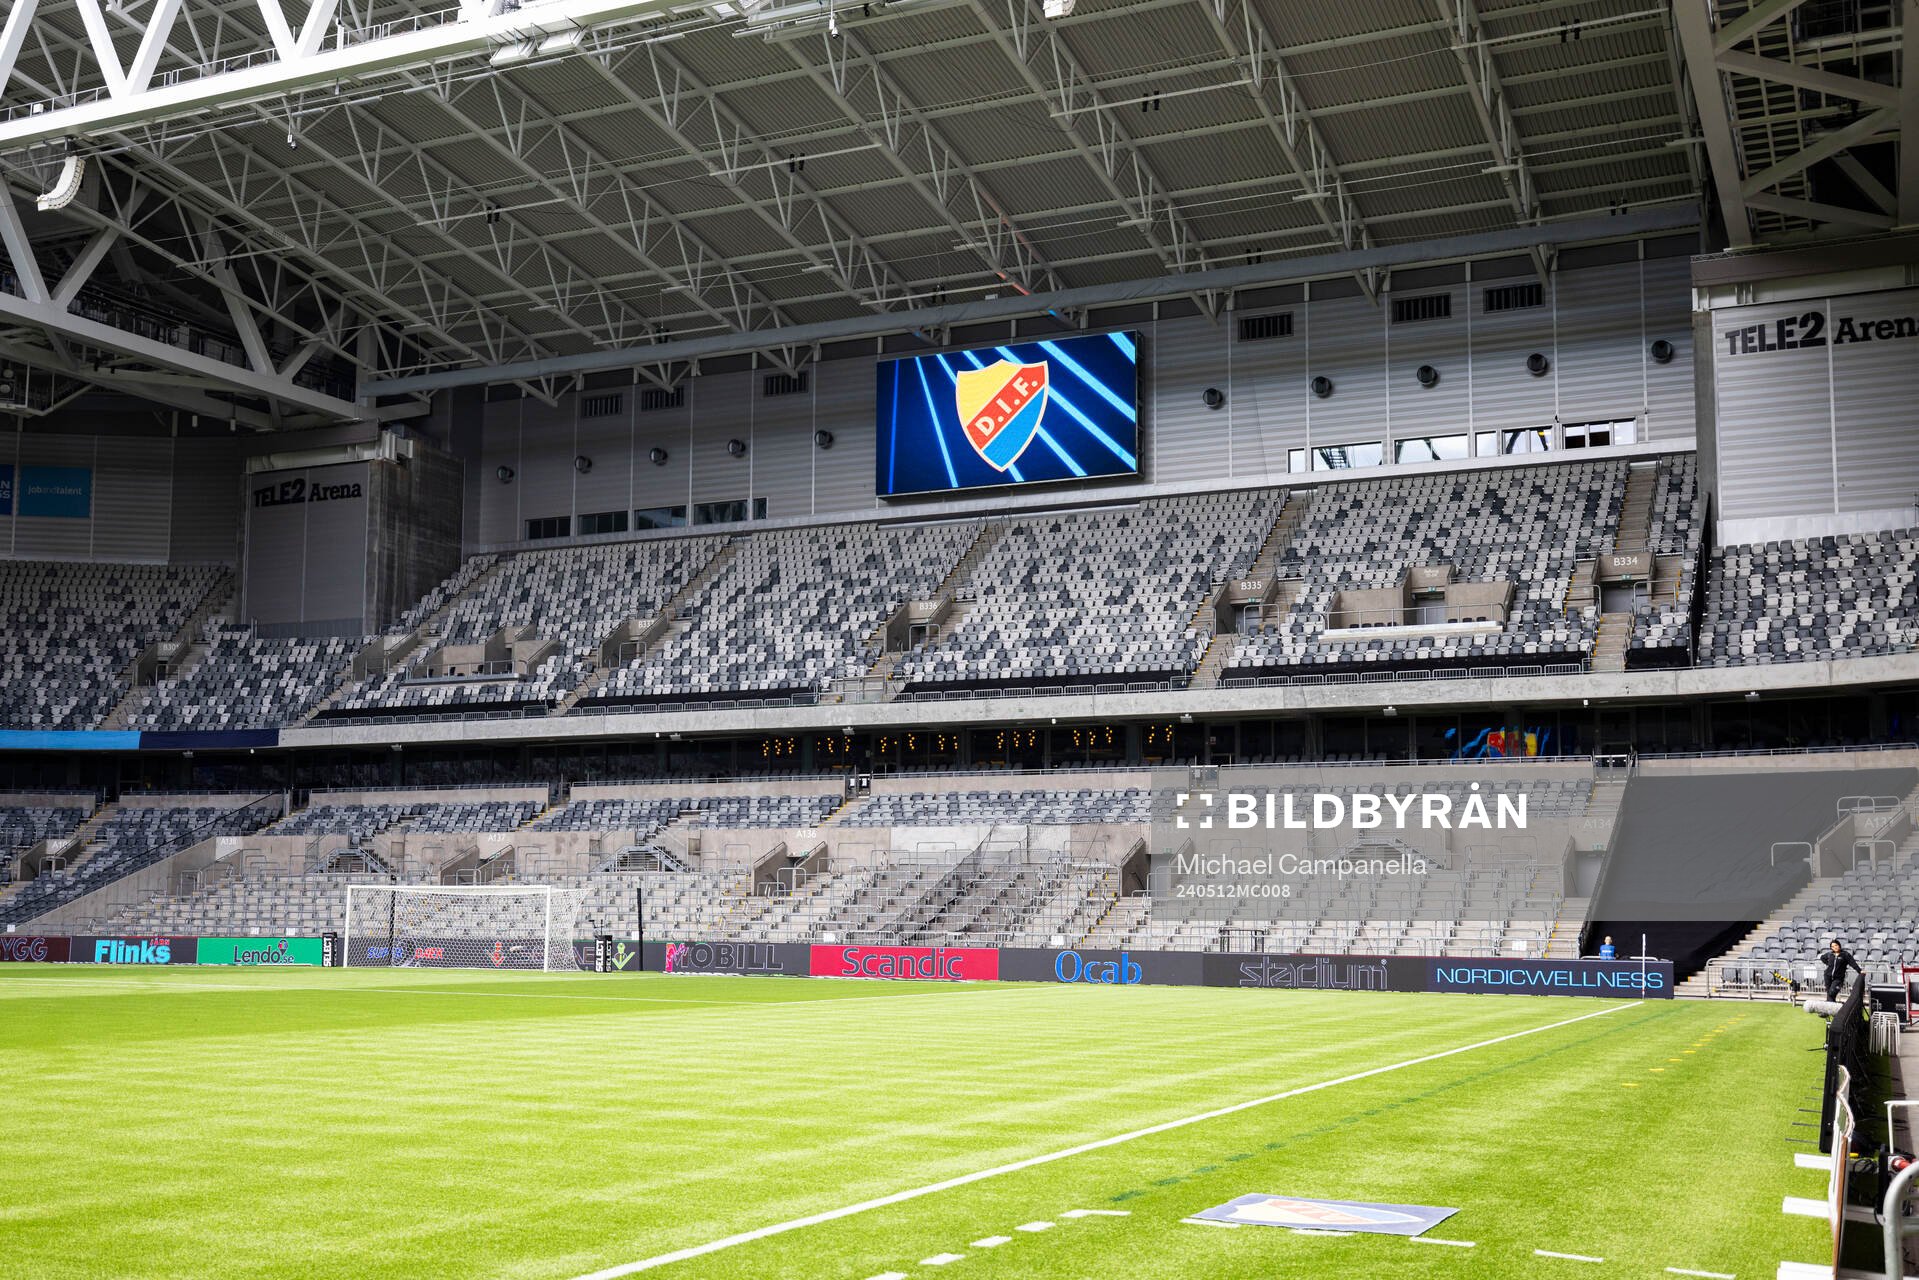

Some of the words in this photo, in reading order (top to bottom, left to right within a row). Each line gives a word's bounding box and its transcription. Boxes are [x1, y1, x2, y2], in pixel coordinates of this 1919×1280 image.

[1725, 311, 1826, 355] TELE2
[1833, 317, 1919, 344] Aren
[254, 478, 306, 507] TELE2
[308, 483, 362, 502] Arena
[1613, 556, 1638, 566] B334
[1240, 580, 1262, 590] B335
[919, 601, 938, 610] B336
[796, 830, 817, 839] A136
[1583, 818, 1611, 829] A134
[95, 939, 171, 964] Flinks
[323, 937, 332, 967] SELECT
[595, 940, 604, 972] SELECT
[665, 942, 783, 972] MOBILL
[842, 948, 963, 979] Scandic
[1054, 950, 1143, 985] Ocab
